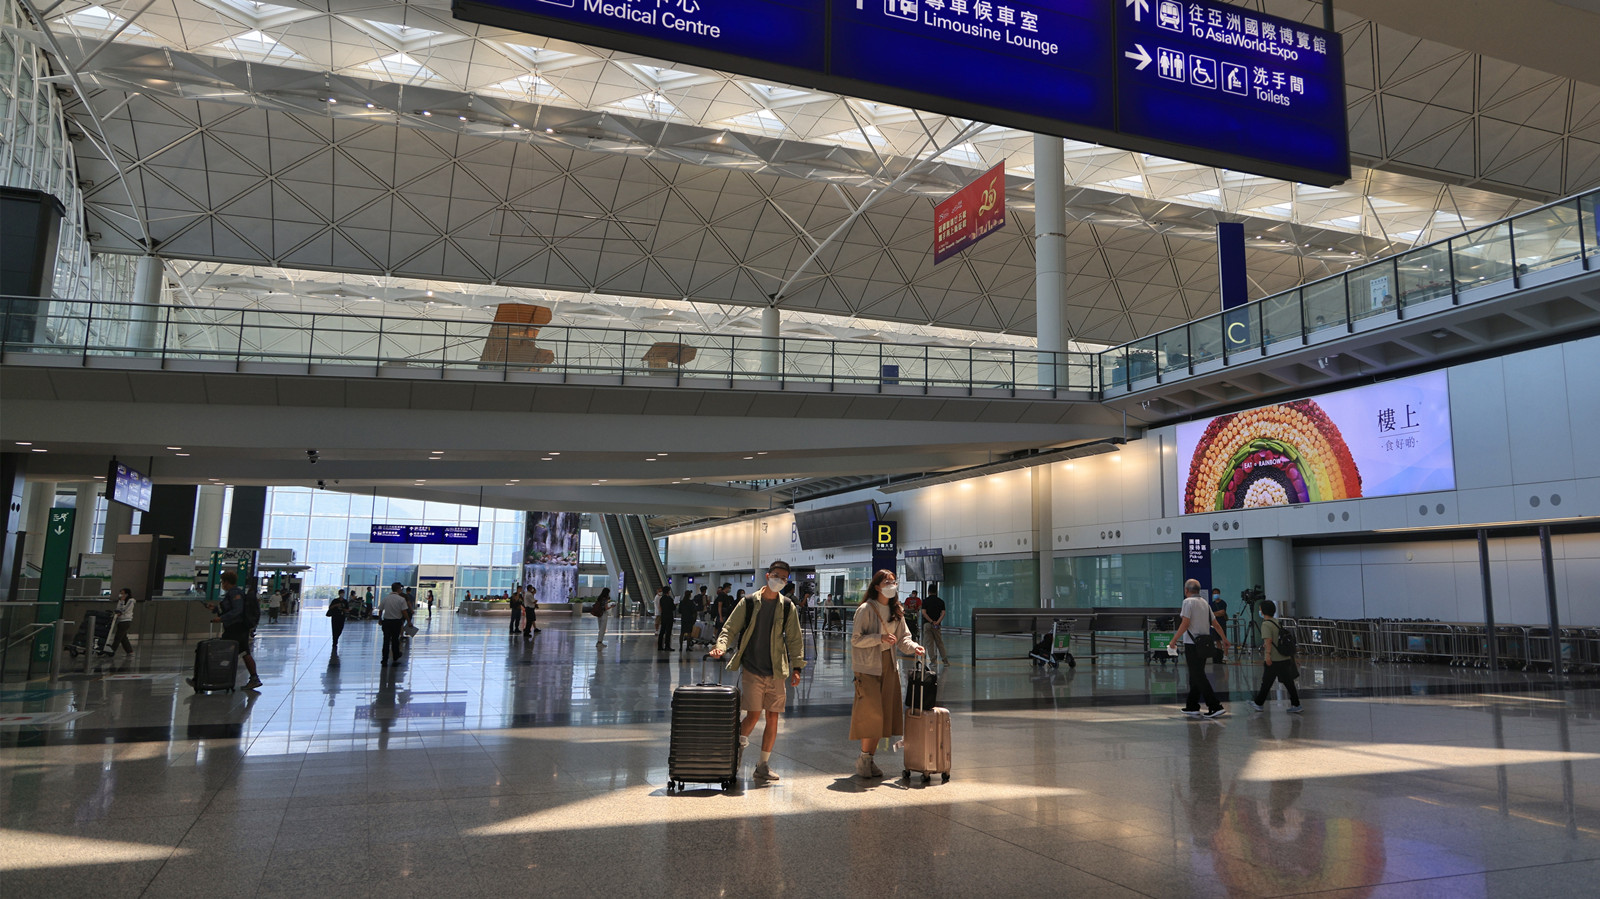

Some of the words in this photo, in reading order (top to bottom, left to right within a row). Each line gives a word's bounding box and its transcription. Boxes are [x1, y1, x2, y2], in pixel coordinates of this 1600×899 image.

[583, 0, 657, 25] Medical
[662, 12, 721, 38] Centre
[924, 11, 1001, 41] Limousine
[1006, 30, 1059, 55] Lounge
[1189, 3, 1327, 55] 往亞洲國際博覽館
[1188, 22, 1204, 39] To
[1205, 27, 1299, 61] AsiaWorld-Expo
[1253, 66, 1304, 95] 洗手間
[1253, 86, 1290, 107] Toilets
[978, 176, 998, 217] 25
[1228, 322, 1246, 344] C
[1377, 404, 1420, 432] 樓上
[1259, 458, 1281, 467] RAINBOW
[878, 524, 892, 543] B
